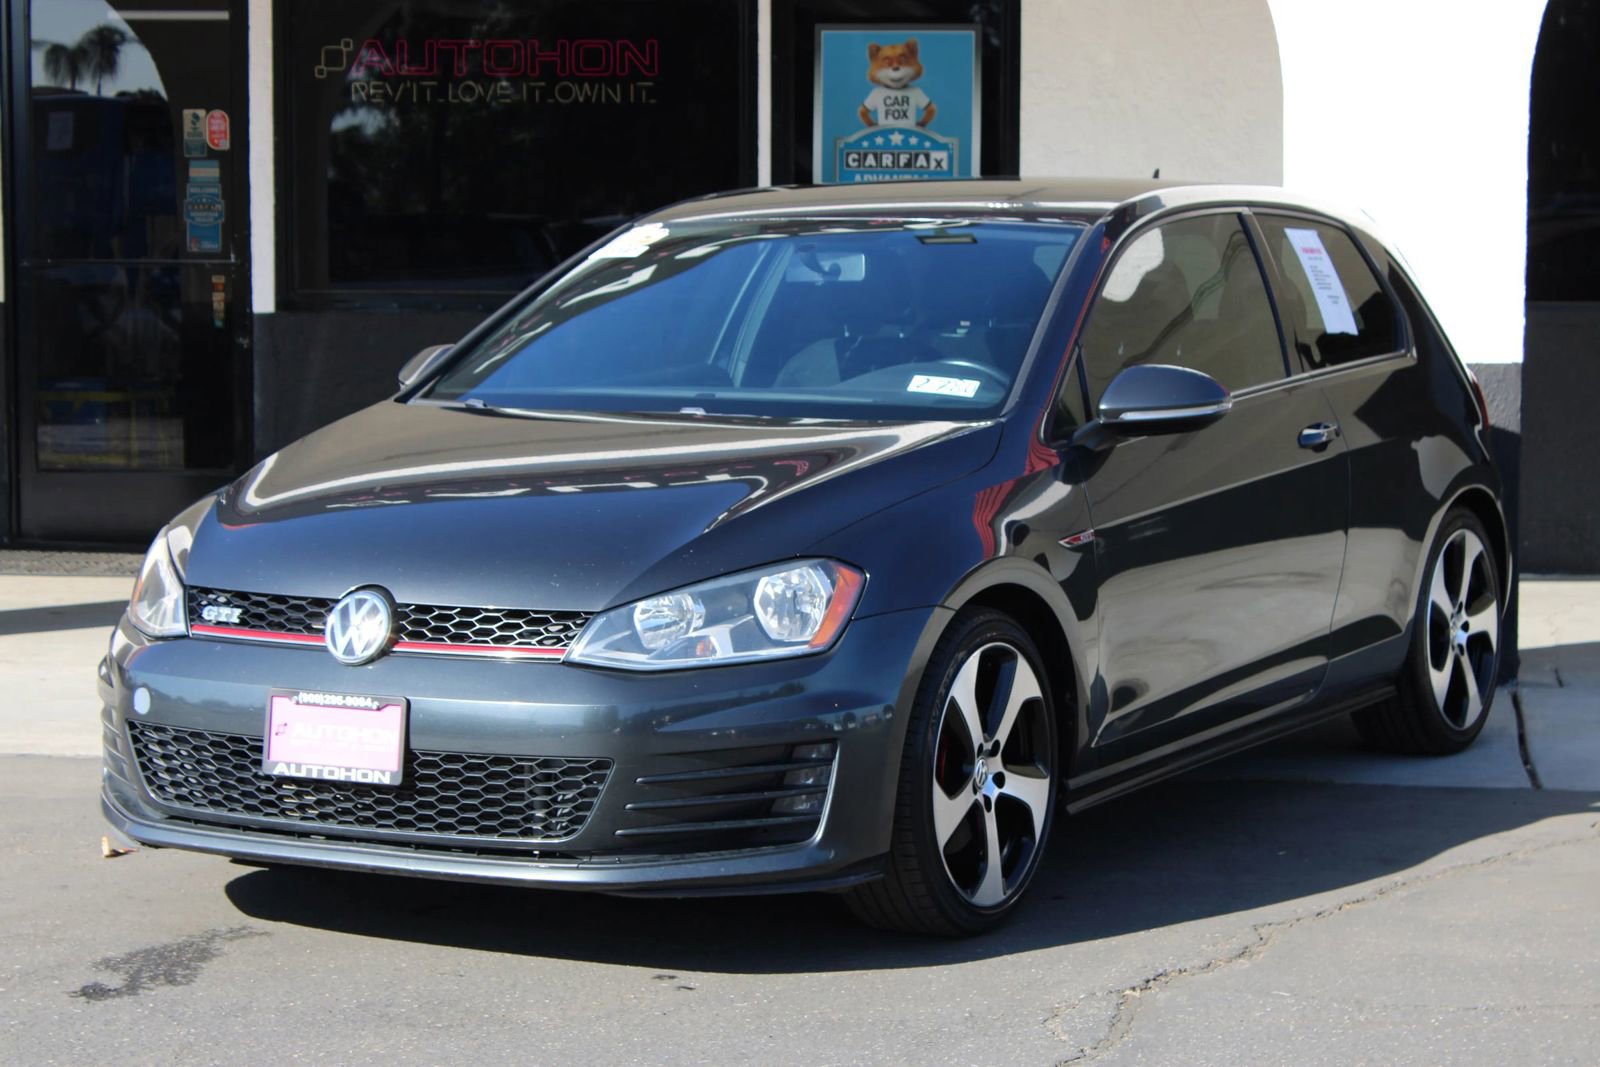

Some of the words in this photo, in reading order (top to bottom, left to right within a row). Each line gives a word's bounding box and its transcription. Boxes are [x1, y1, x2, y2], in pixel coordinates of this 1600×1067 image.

[348, 39, 659, 78] AUTOHON
[883, 95, 910, 108] CAR
[884, 108, 909, 120] FOX
[846, 152, 946, 169] CARFAX
[201, 604, 243, 624] GTI
[272, 762, 391, 785] AUTOHON
